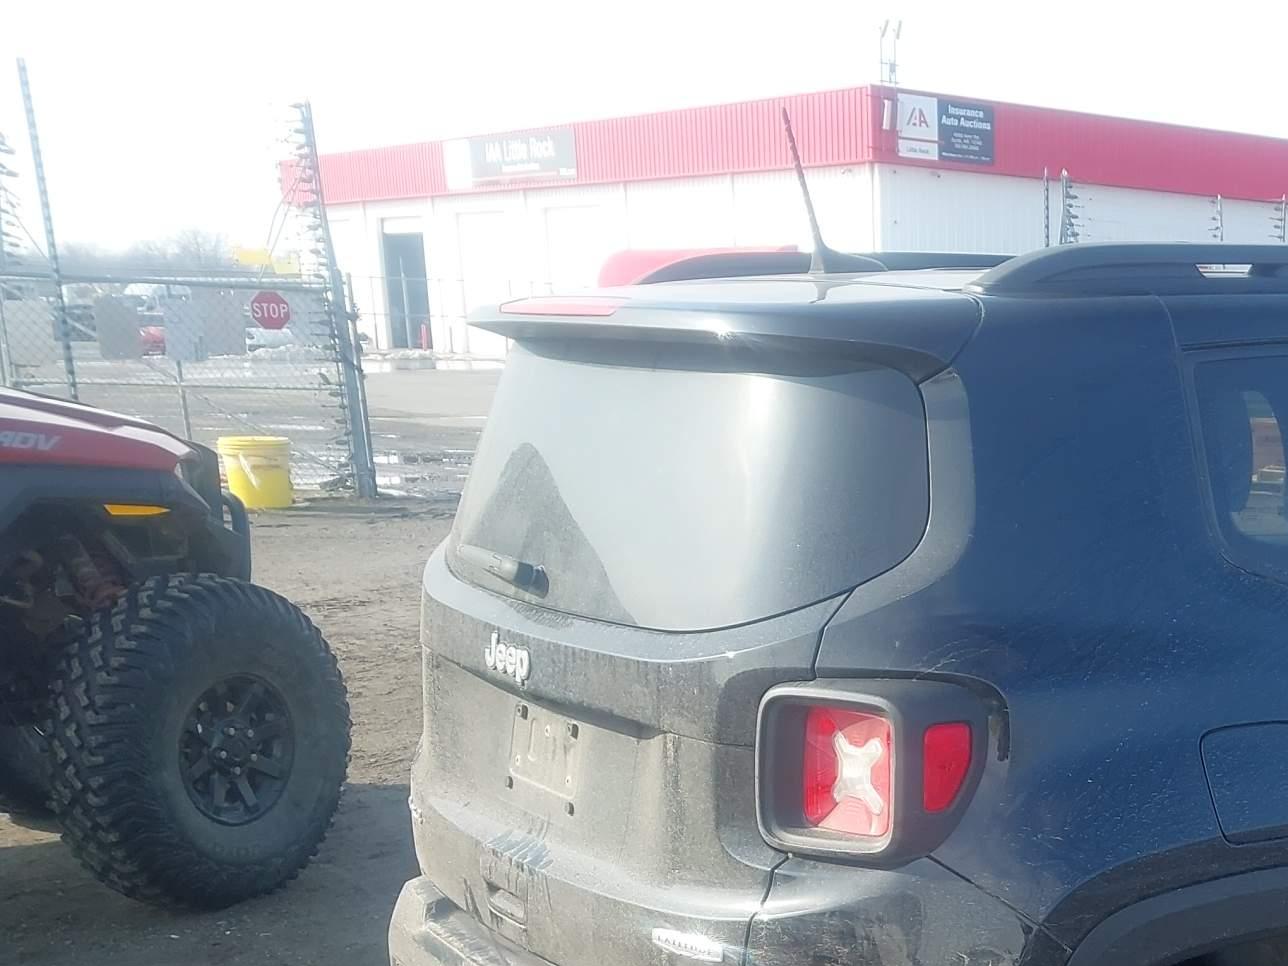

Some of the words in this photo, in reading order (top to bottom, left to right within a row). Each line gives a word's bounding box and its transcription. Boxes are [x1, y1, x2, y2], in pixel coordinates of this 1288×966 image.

[948, 104, 984, 119] Insurance
[941, 115, 959, 127] Auto
[959, 117, 991, 131] Auctions
[252, 303, 288, 318] STOP
[484, 631, 531, 686] Jeep
